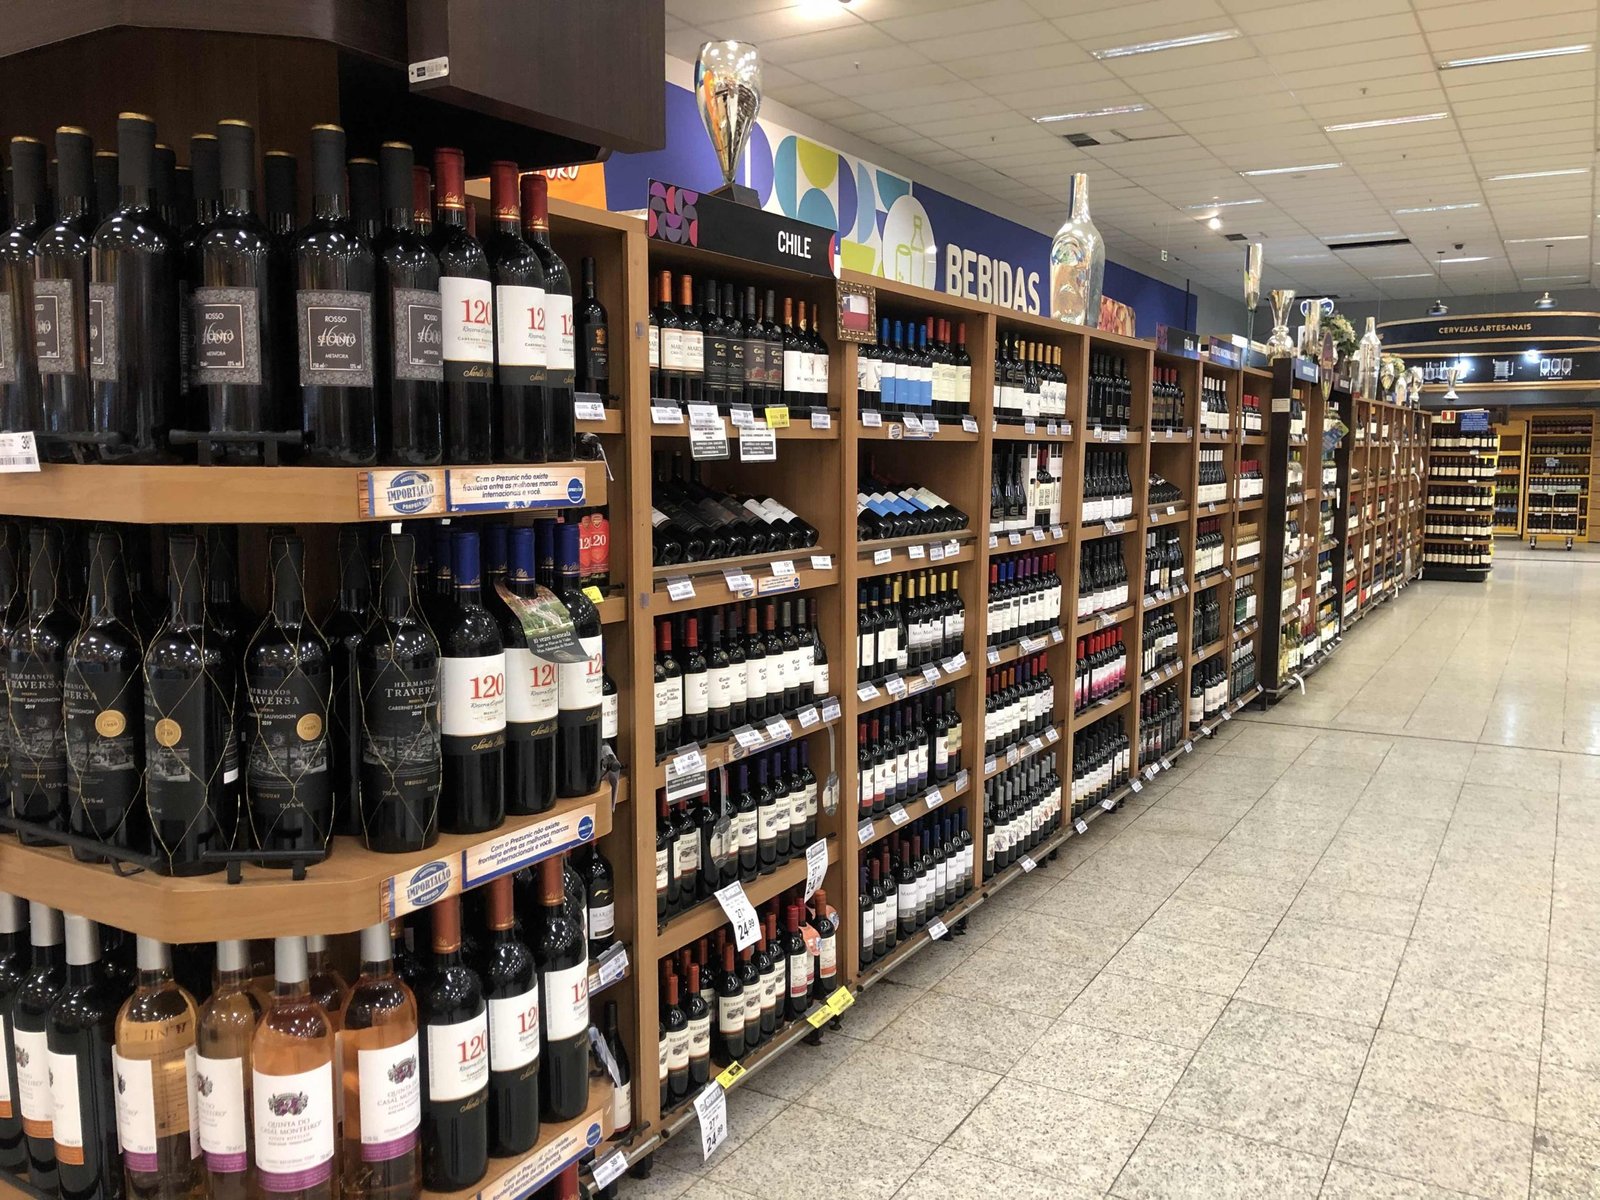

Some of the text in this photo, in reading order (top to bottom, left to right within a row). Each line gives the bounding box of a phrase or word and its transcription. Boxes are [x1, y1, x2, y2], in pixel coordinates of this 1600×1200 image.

[777, 230, 812, 260] CHILE
[946, 243, 1040, 316] BEBIDAS
[325, 315, 347, 323] ROSSO
[1438, 323, 1532, 335] CERVEJAS ARTESANAIS
[470, 672, 504, 700] 120
[478, 852, 502, 865] fronteira
[503, 846, 517, 856] entre
[526, 833, 550, 846] melhores
[550, 824, 569, 835] marcas
[490, 844, 504, 853] Com
[510, 832, 533, 845] Prezunic
[534, 827, 543, 836] não
[544, 821, 560, 831] existe
[496, 847, 534, 866] internacionais
